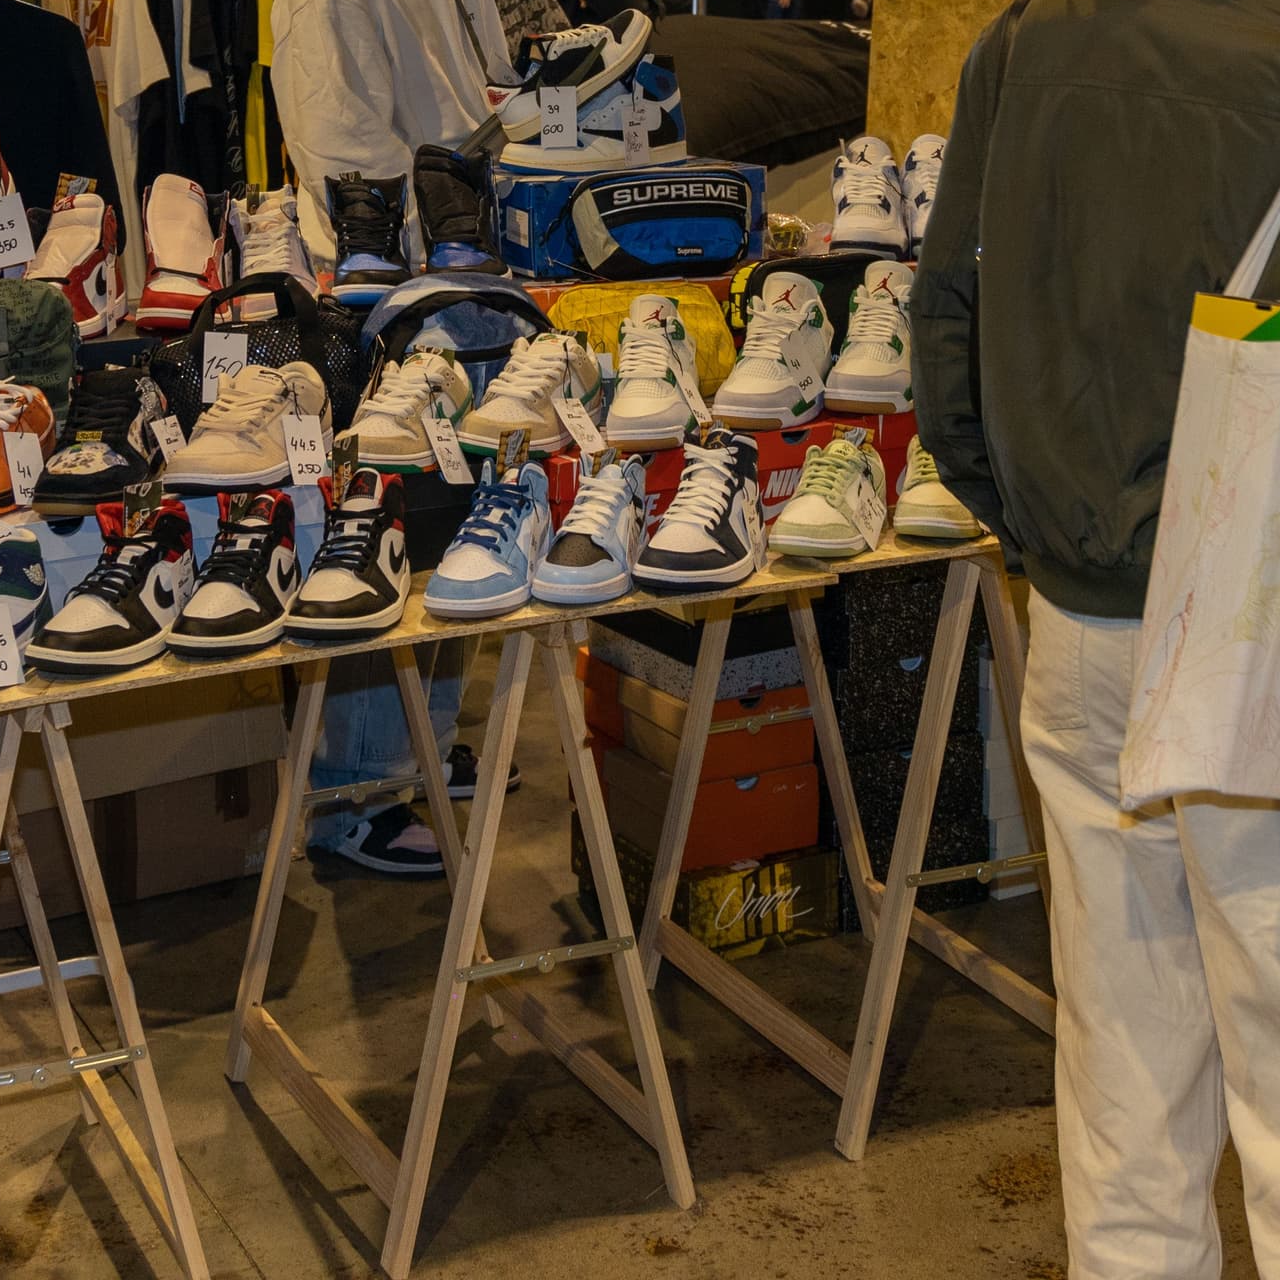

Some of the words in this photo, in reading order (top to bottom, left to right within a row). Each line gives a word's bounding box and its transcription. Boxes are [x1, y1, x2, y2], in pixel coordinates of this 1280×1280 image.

[547, 104, 559, 114] 39
[542, 124, 564, 135] 600
[612, 183, 739, 206] SUPREME
[677, 247, 702, 256] Supreme
[290, 437, 316, 451] 44.5
[297, 463, 322, 474] 250
